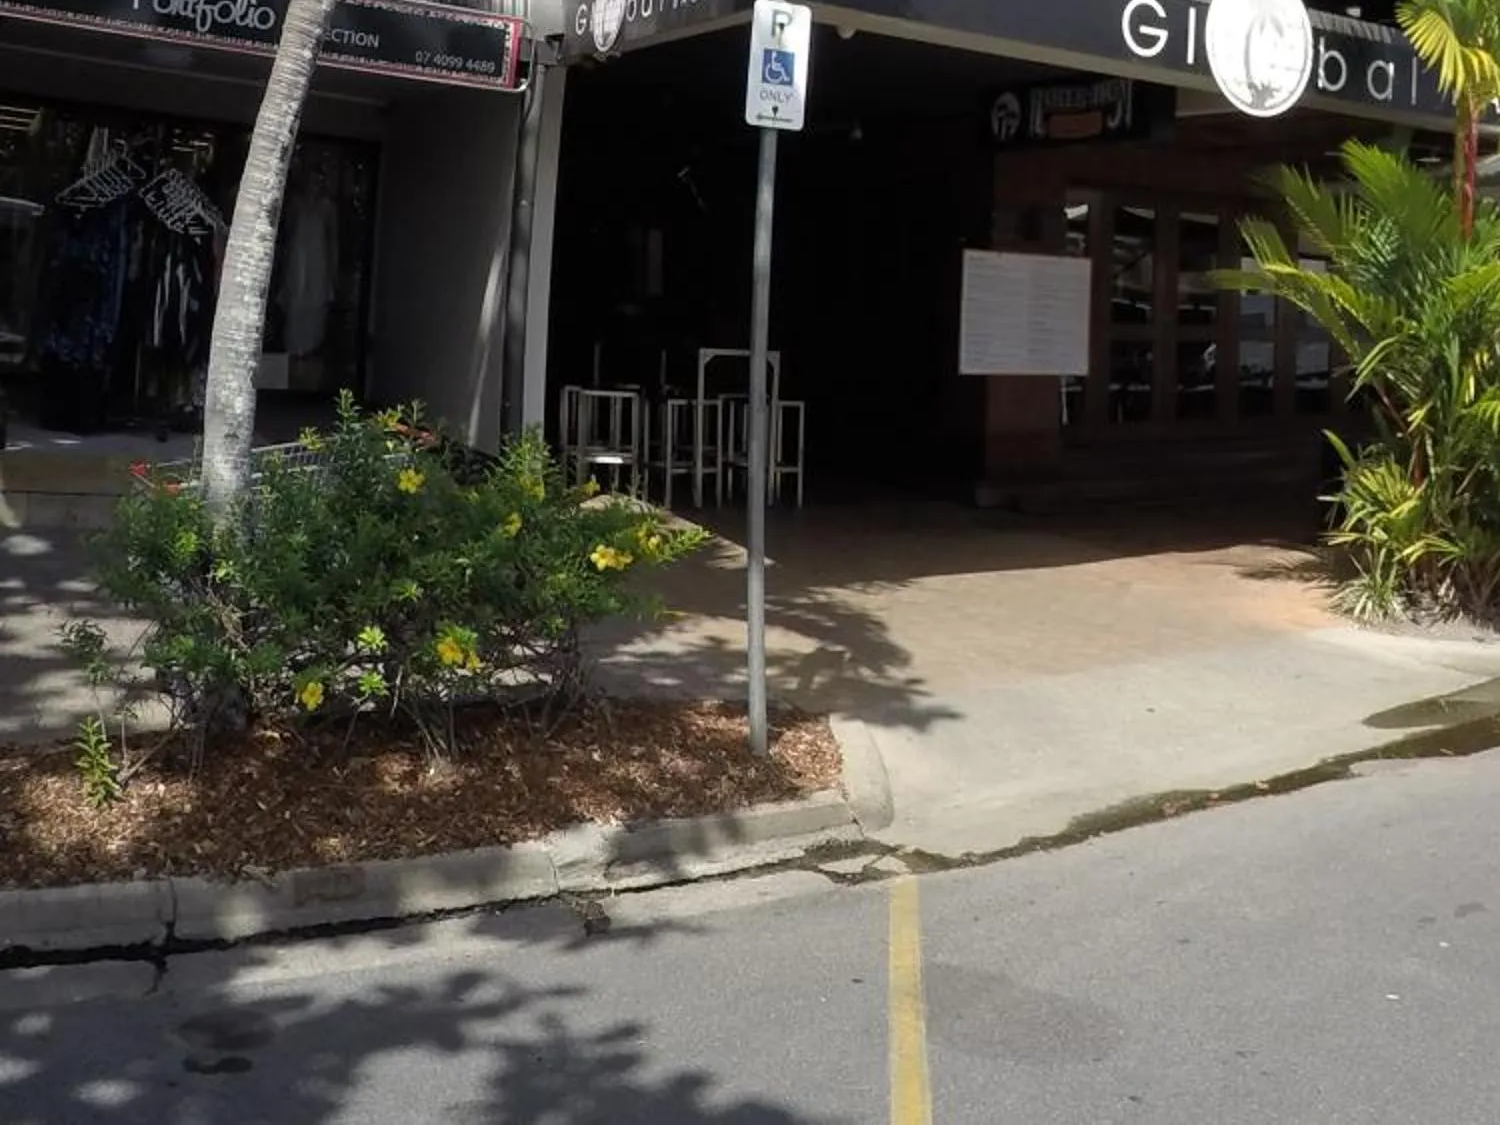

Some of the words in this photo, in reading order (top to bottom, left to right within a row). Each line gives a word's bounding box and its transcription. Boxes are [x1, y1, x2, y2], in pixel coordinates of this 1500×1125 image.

[771, 9, 793, 37] P
[415, 50, 431, 65] 07
[433, 53, 463, 69] 4099
[759, 90, 793, 105] ONLY
